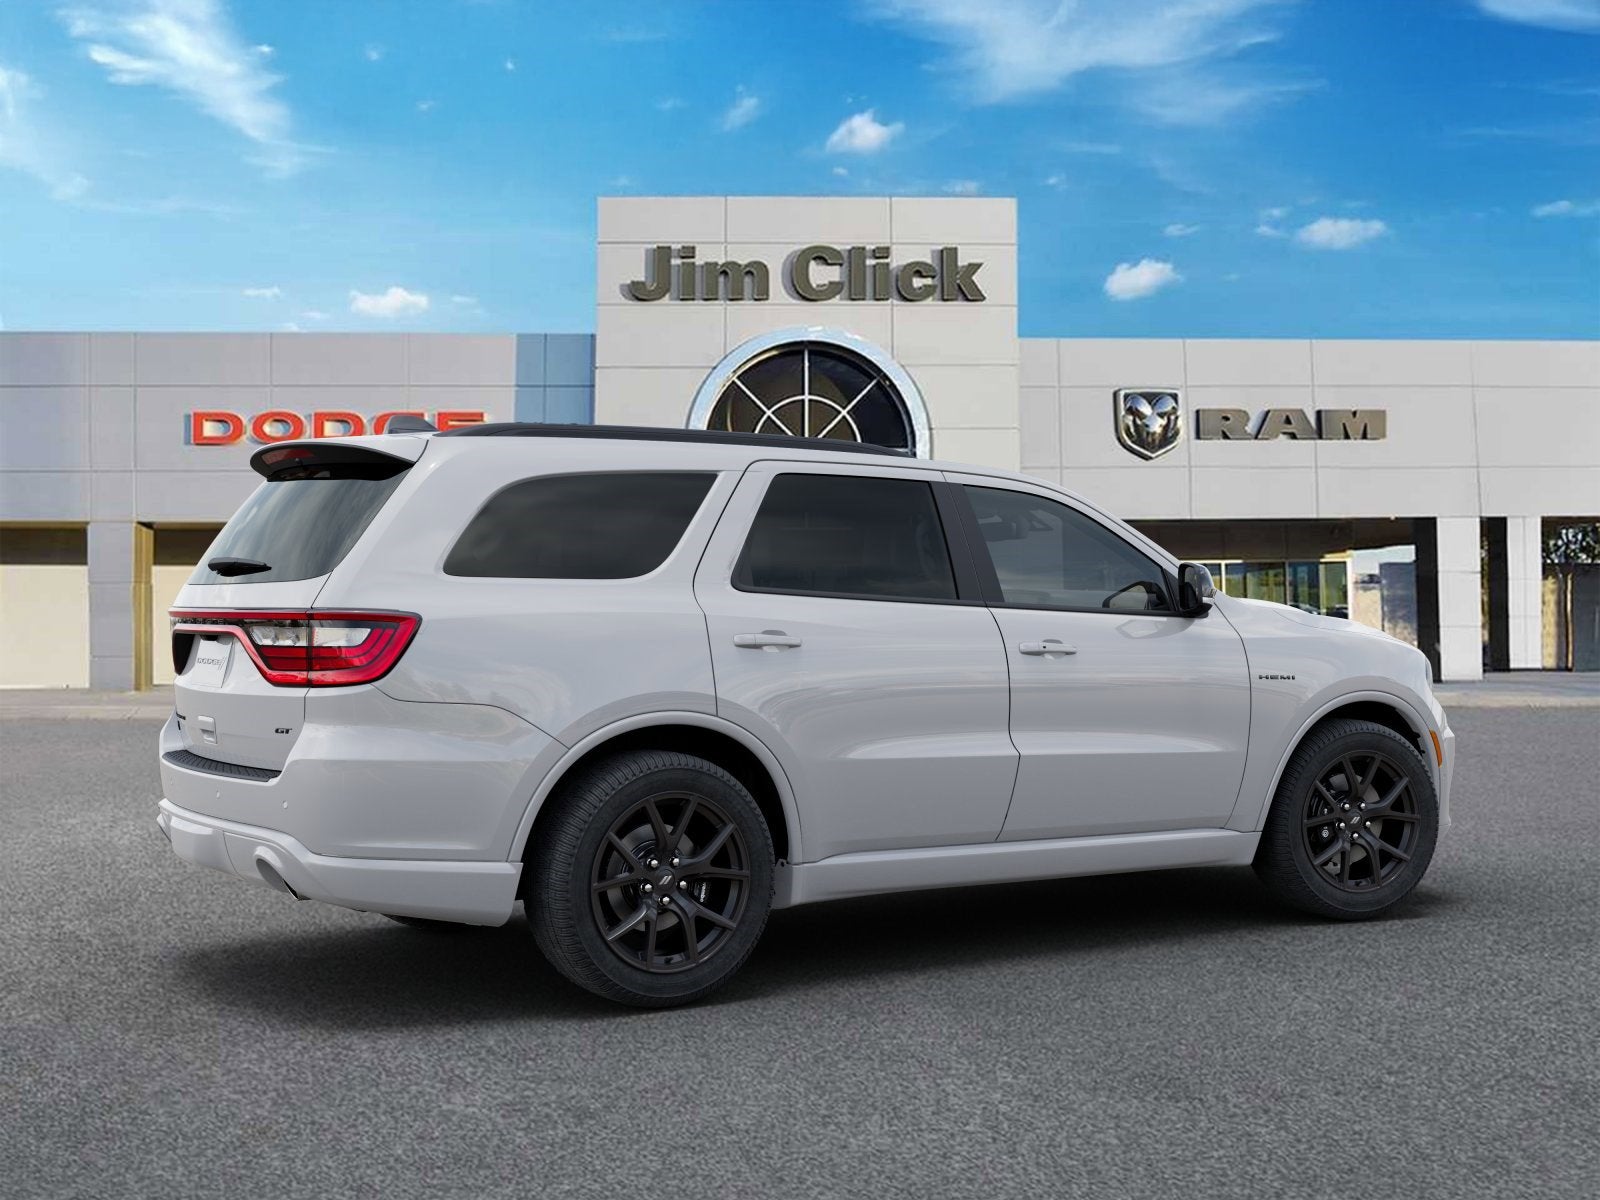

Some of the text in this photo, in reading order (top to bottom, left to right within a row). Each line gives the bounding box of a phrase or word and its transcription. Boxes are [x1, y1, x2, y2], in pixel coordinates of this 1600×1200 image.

[627, 244, 987, 302] Jim Click
[1195, 408, 1387, 440] RAM
[274, 727, 292, 735] GT
